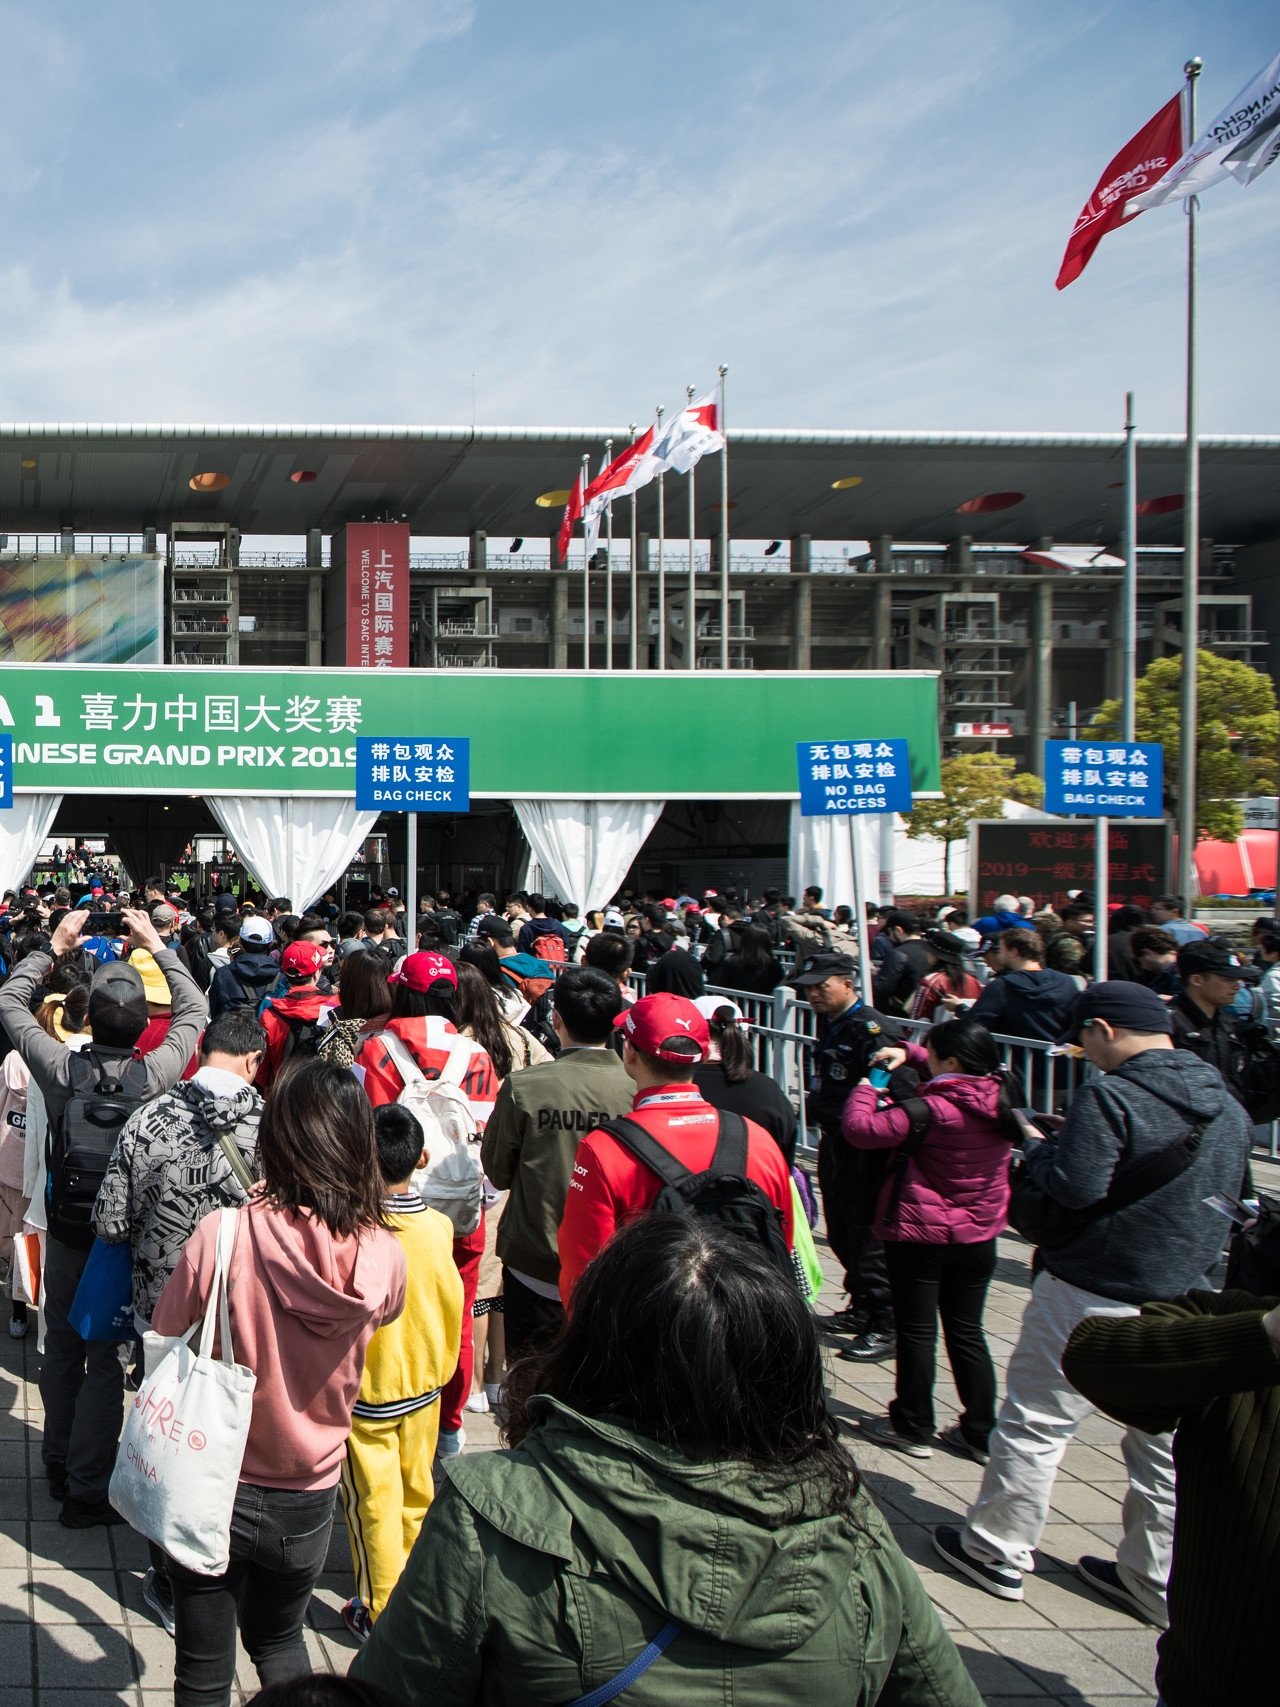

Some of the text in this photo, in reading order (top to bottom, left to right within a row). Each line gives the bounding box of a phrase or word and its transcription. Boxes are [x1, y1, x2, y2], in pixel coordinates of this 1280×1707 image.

[361, 549, 370, 599] WELCOME
[361, 602, 370, 616] TO
[361, 618, 370, 641] SAIC
[35, 695, 61, 727] 1
[79, 692, 363, 734] 喜力中国大奖赛
[12, 742, 96, 764] INESE
[103, 744, 211, 765] GRAND
[217, 746, 286, 767] PRIX
[371, 744, 454, 761] 带包观众
[809, 742, 894, 760] 无包观众
[1060, 747, 1149, 766] 带包观众
[372, 766, 454, 783] 排队安检
[811, 762, 896, 780] 排队安检
[1061, 769, 1149, 788] 排队安检
[374, 791, 452, 801] BAG CHECK
[825, 783, 886, 796] NO BAG
[825, 797, 887, 810] ACCESS
[1064, 793, 1146, 806] BAG CHECK
[126, 1442, 157, 1483] CHINA
